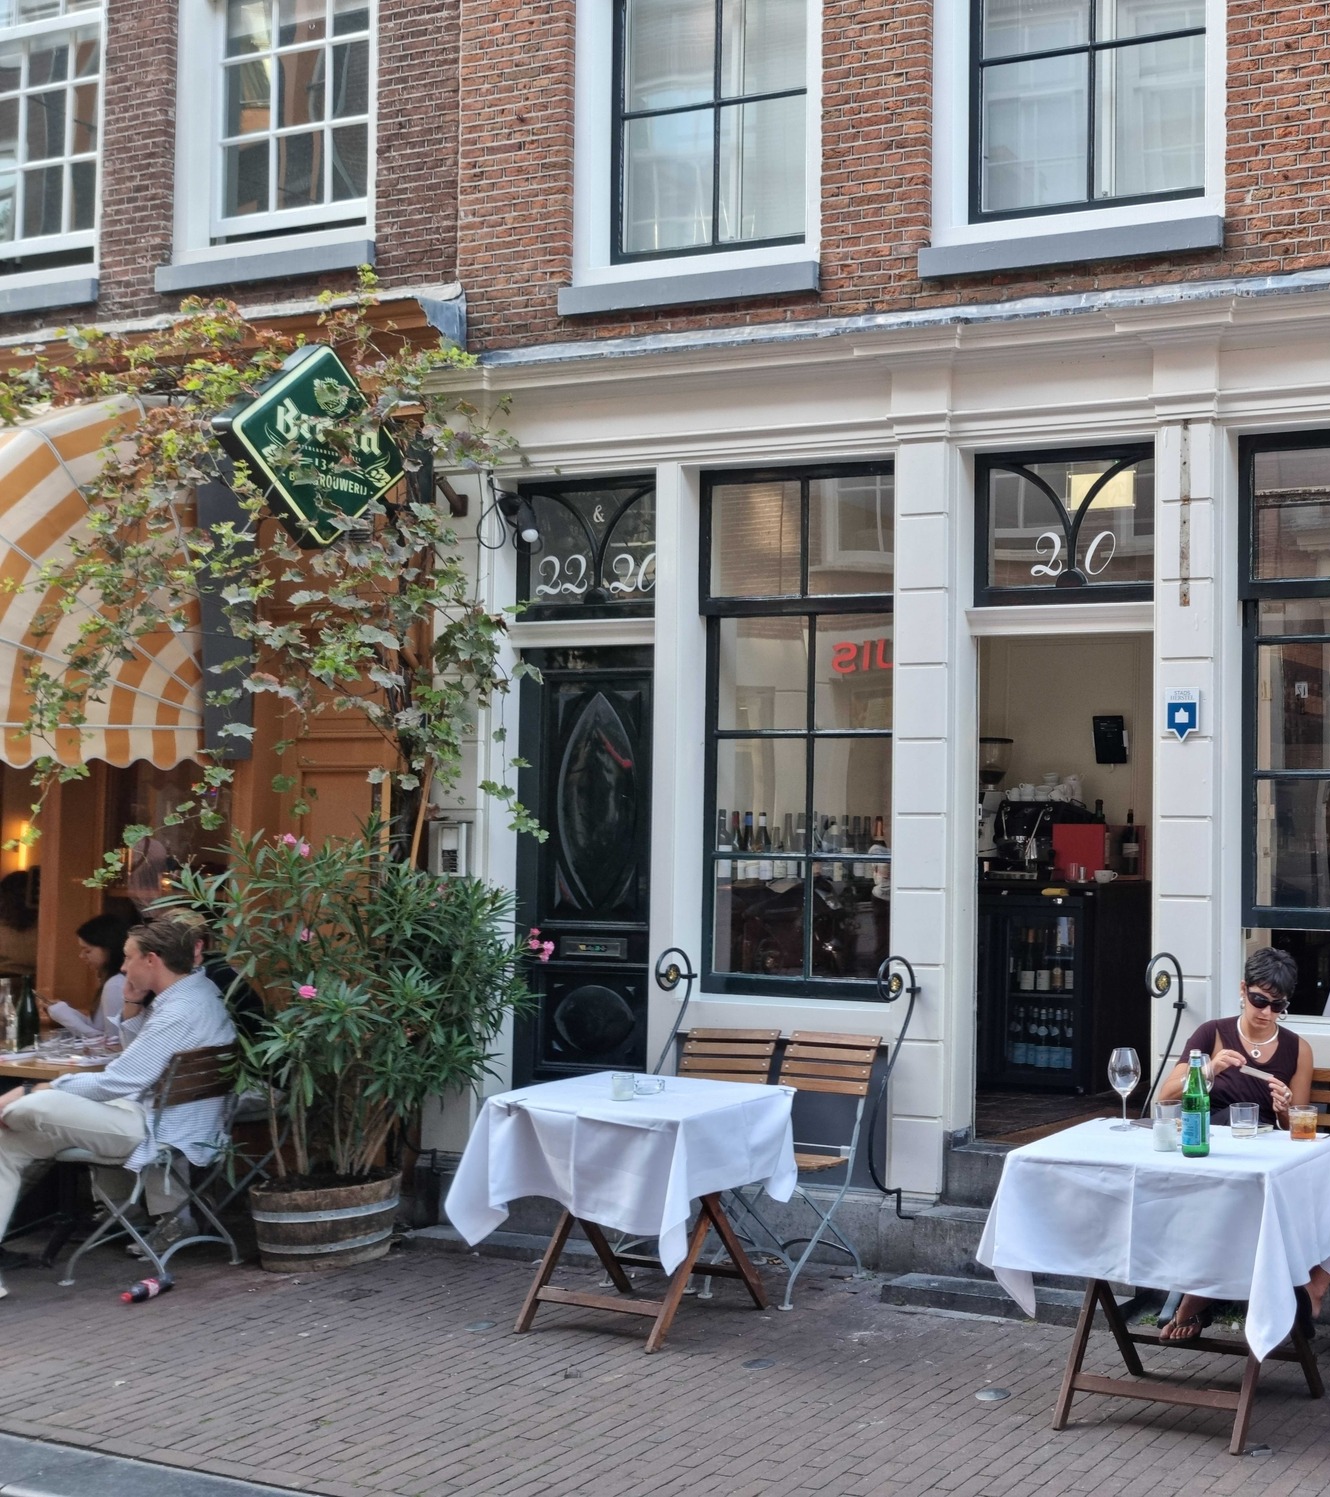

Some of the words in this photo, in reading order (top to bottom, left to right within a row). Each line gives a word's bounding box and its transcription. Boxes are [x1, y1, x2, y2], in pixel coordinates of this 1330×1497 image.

[276, 397, 382, 458] Brd
[593, 504, 605, 523] &
[535, 554, 588, 595] 22
[609, 552, 656, 593] 20
[1030, 530, 1116, 577] 20
